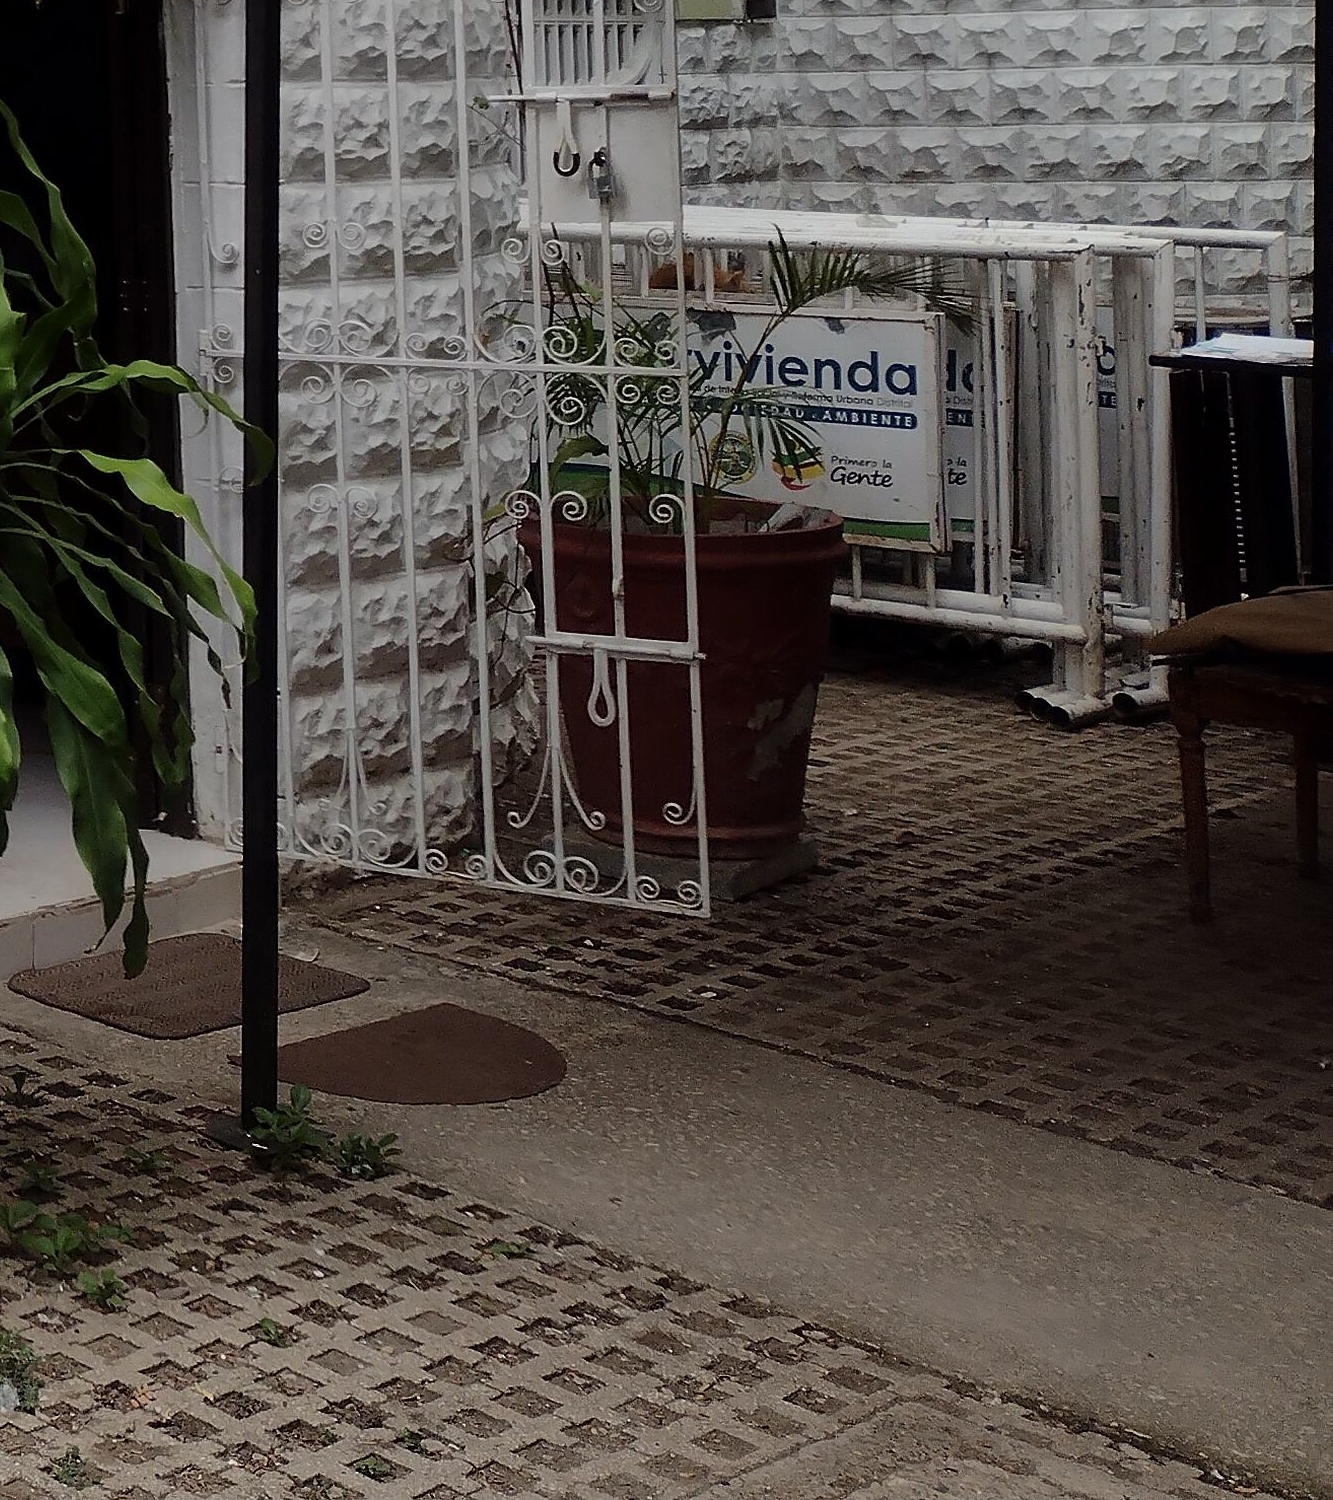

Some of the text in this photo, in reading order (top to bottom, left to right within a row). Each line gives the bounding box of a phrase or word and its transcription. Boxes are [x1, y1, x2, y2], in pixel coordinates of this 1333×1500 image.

[687, 341, 918, 396] vivienda
[836, 394, 874, 406] Urbana
[822, 408, 913, 428] AMBIENTE
[830, 465, 894, 488] Gente
